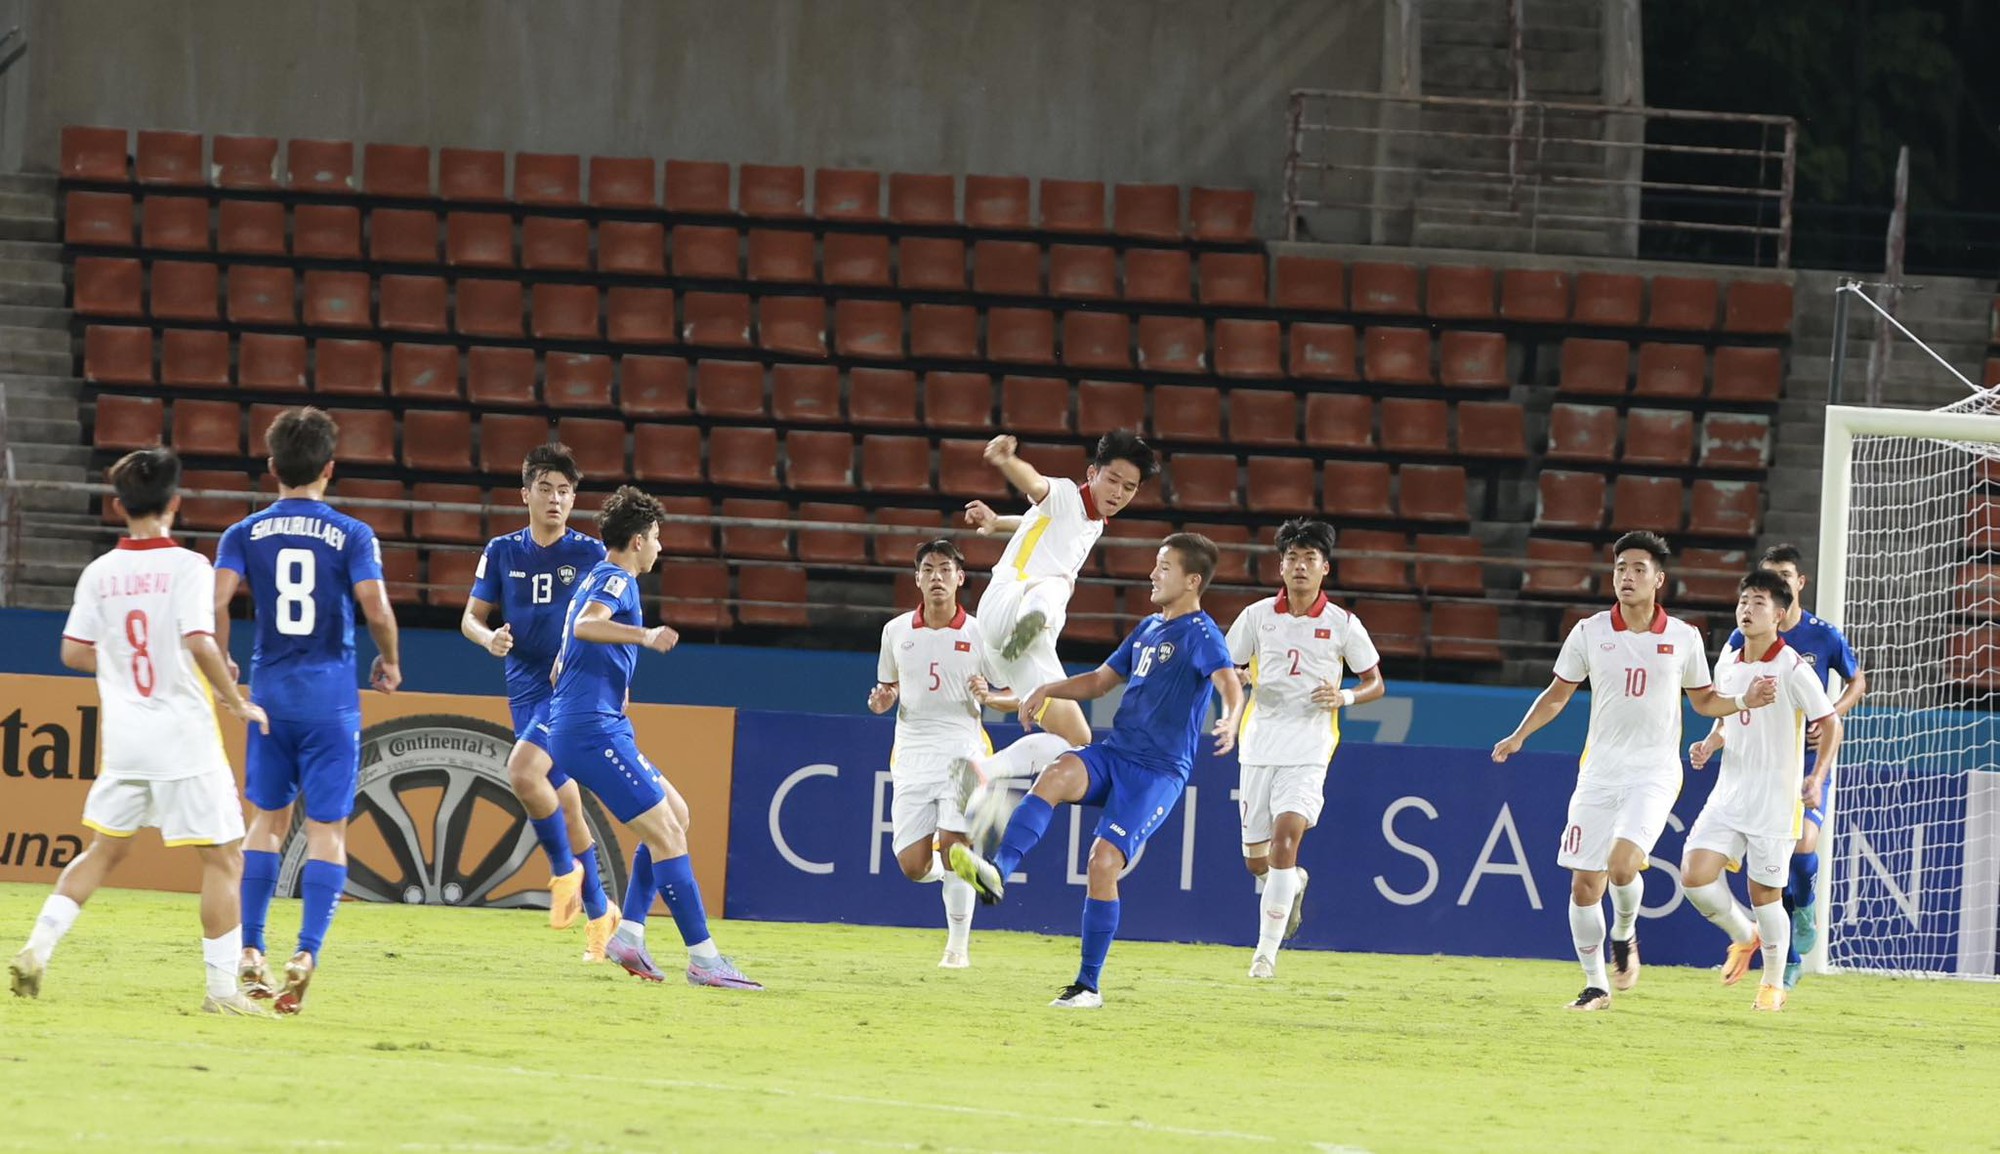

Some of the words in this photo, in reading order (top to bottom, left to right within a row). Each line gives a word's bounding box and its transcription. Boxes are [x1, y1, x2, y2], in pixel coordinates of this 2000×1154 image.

[276, 548, 315, 635] 8
[531, 573, 553, 604] 13
[125, 609, 156, 698] 8
[1133, 646, 1156, 678] 16
[1287, 648, 1301, 676] 2
[928, 662, 940, 691] 5
[1625, 667, 1647, 697] 10
[0, 705, 98, 780] tal
[388, 733, 484, 757] Continental
[1109, 823, 1127, 837] JAKO
[1563, 824, 1581, 856] 10
[1373, 795, 1926, 933] SASN
